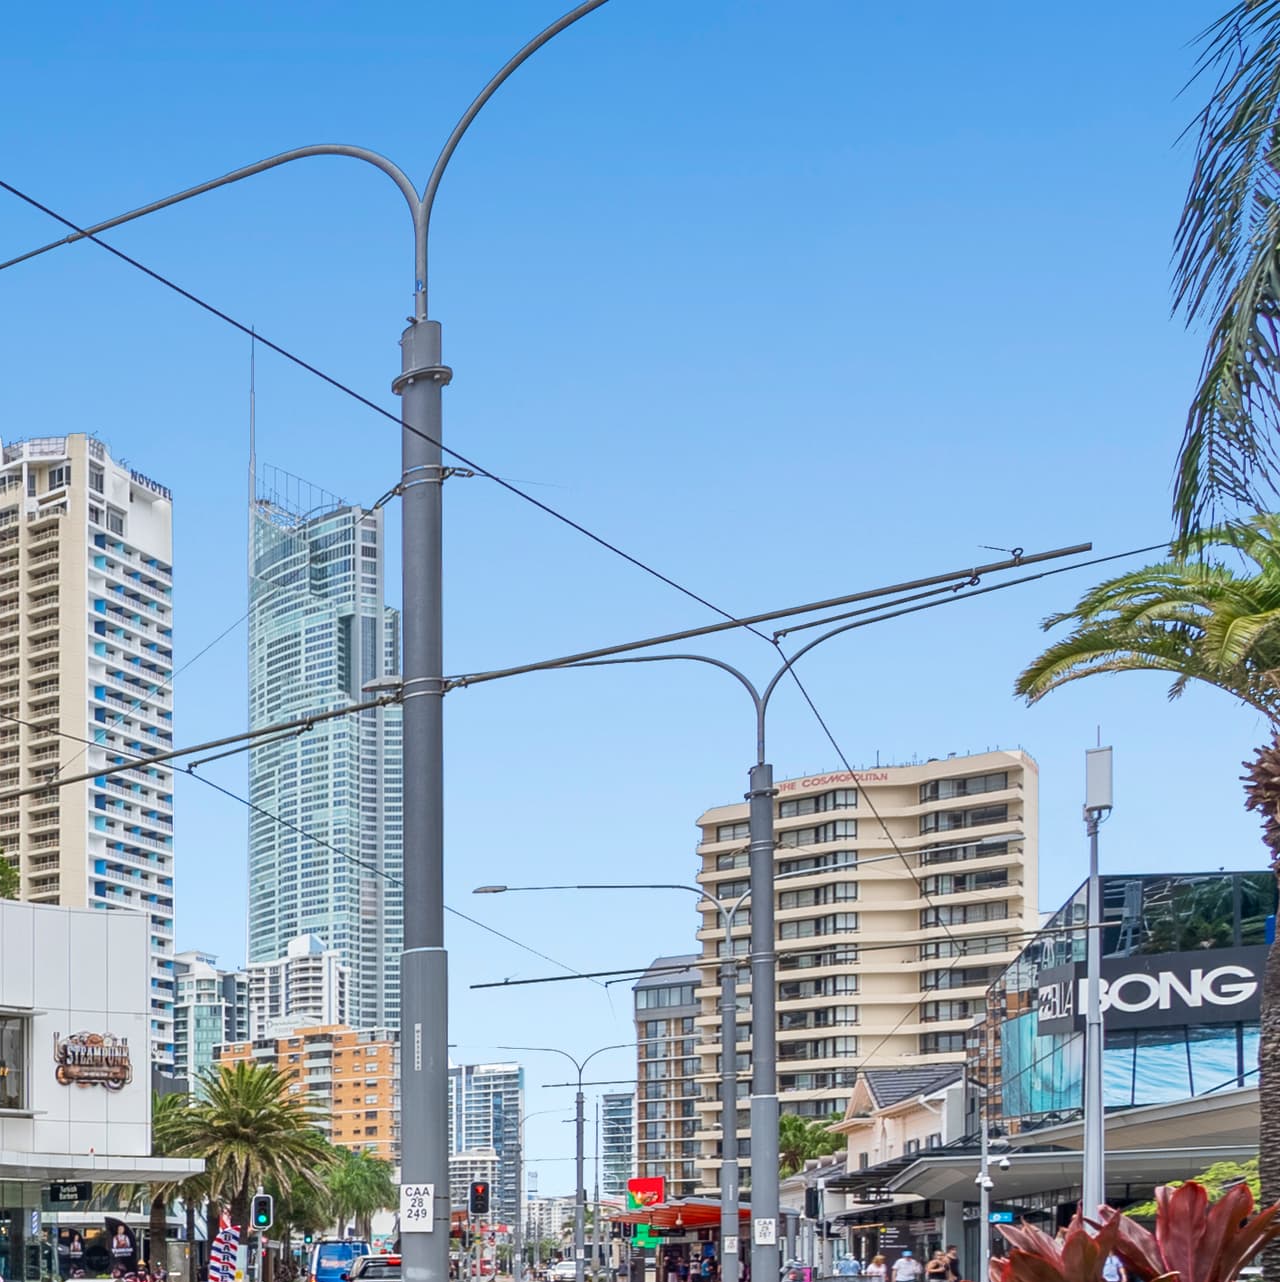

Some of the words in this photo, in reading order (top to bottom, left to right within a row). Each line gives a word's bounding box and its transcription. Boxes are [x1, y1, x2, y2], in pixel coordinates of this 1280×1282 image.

[130, 468, 173, 500] NOVOTEL
[405, 1186, 430, 1198] CAA
[410, 1198, 424, 1208] 28
[407, 1208, 427, 1219] 249
